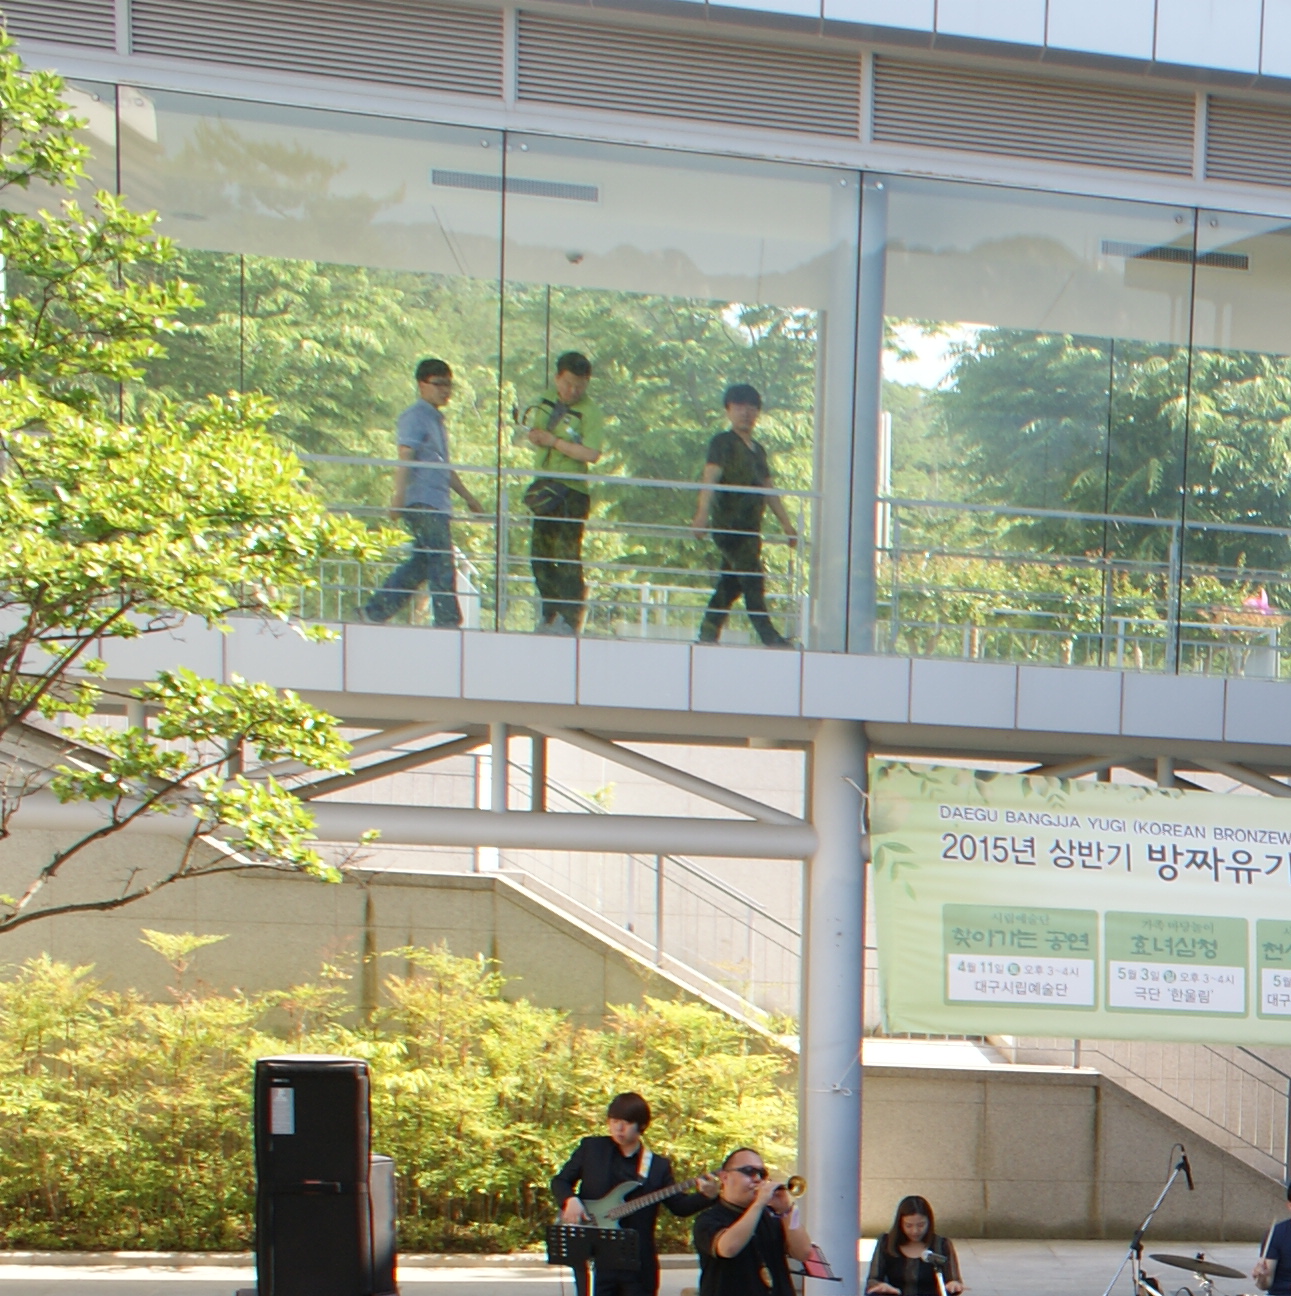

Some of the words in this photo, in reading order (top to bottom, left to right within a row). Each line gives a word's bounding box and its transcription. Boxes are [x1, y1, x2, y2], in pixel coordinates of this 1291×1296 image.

[940, 805, 998, 823] DAEGU
[1005, 810, 1081, 829] BANGJJA
[1087, 816, 1127, 833] YUGI
[1133, 819, 1207, 840] (KOREAN
[942, 832, 1037, 867] 2015년
[1049, 838, 1132, 872] 상반기
[952, 927, 1038, 949] 찾아가는
[1044, 930, 1090, 951] 공연
[975, 980, 1068, 997] 대구시립예술단
[1134, 986, 1161, 1002] 극단
